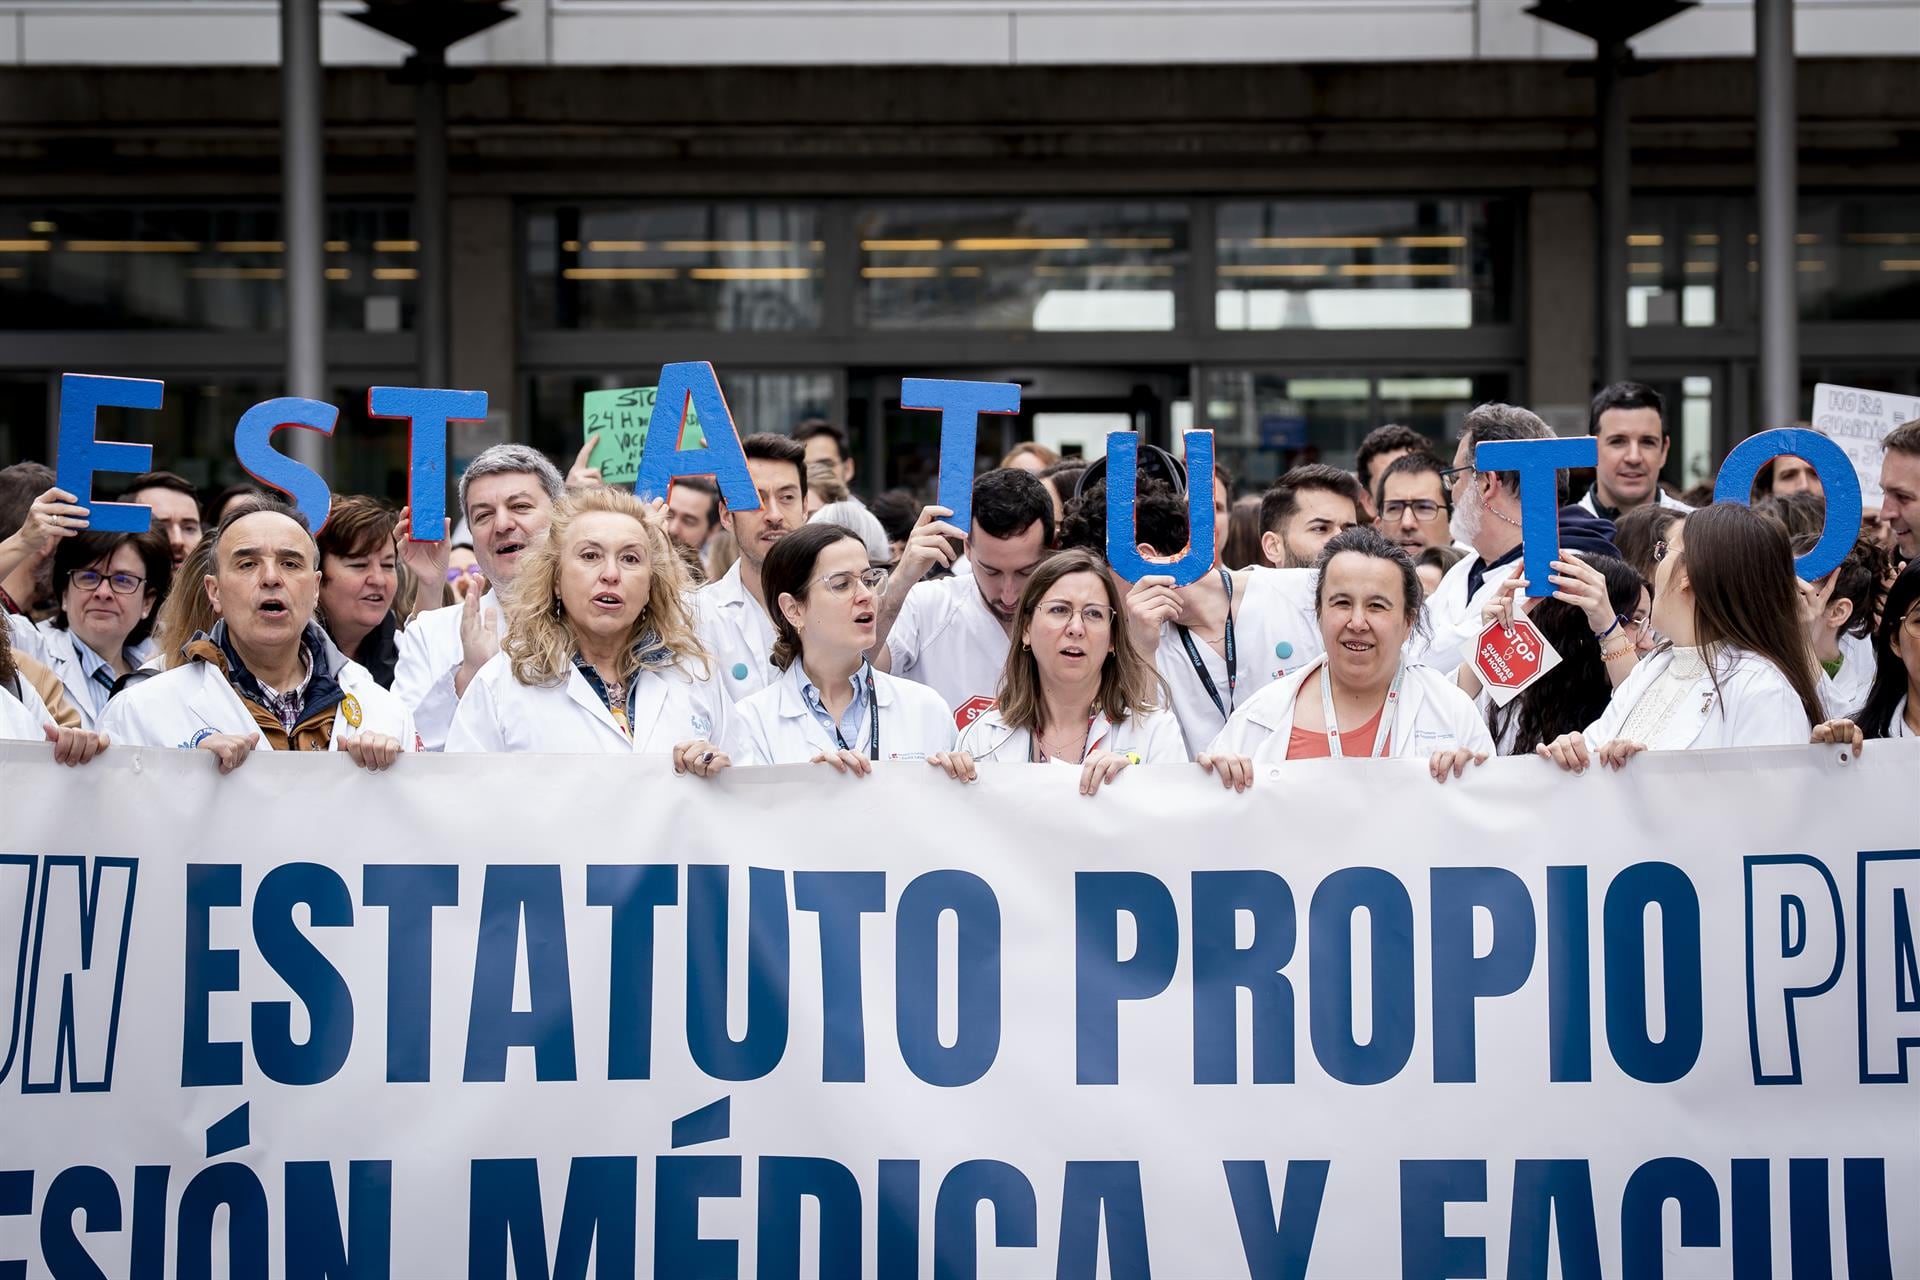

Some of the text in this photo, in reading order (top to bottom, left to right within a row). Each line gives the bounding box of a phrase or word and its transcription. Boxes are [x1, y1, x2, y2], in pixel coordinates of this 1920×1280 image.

[587, 411, 614, 434] 24
[621, 411, 634, 428] H
[1503, 628, 1536, 662] STOP
[1480, 648, 1509, 683] 24 HORAS
[181, 862, 1000, 1087] ESTATUTO
[1075, 862, 1703, 1085] PROPIO
[468, 1097, 1151, 1280] MÉDICA
[1223, 1160, 1330, 1280] Y
